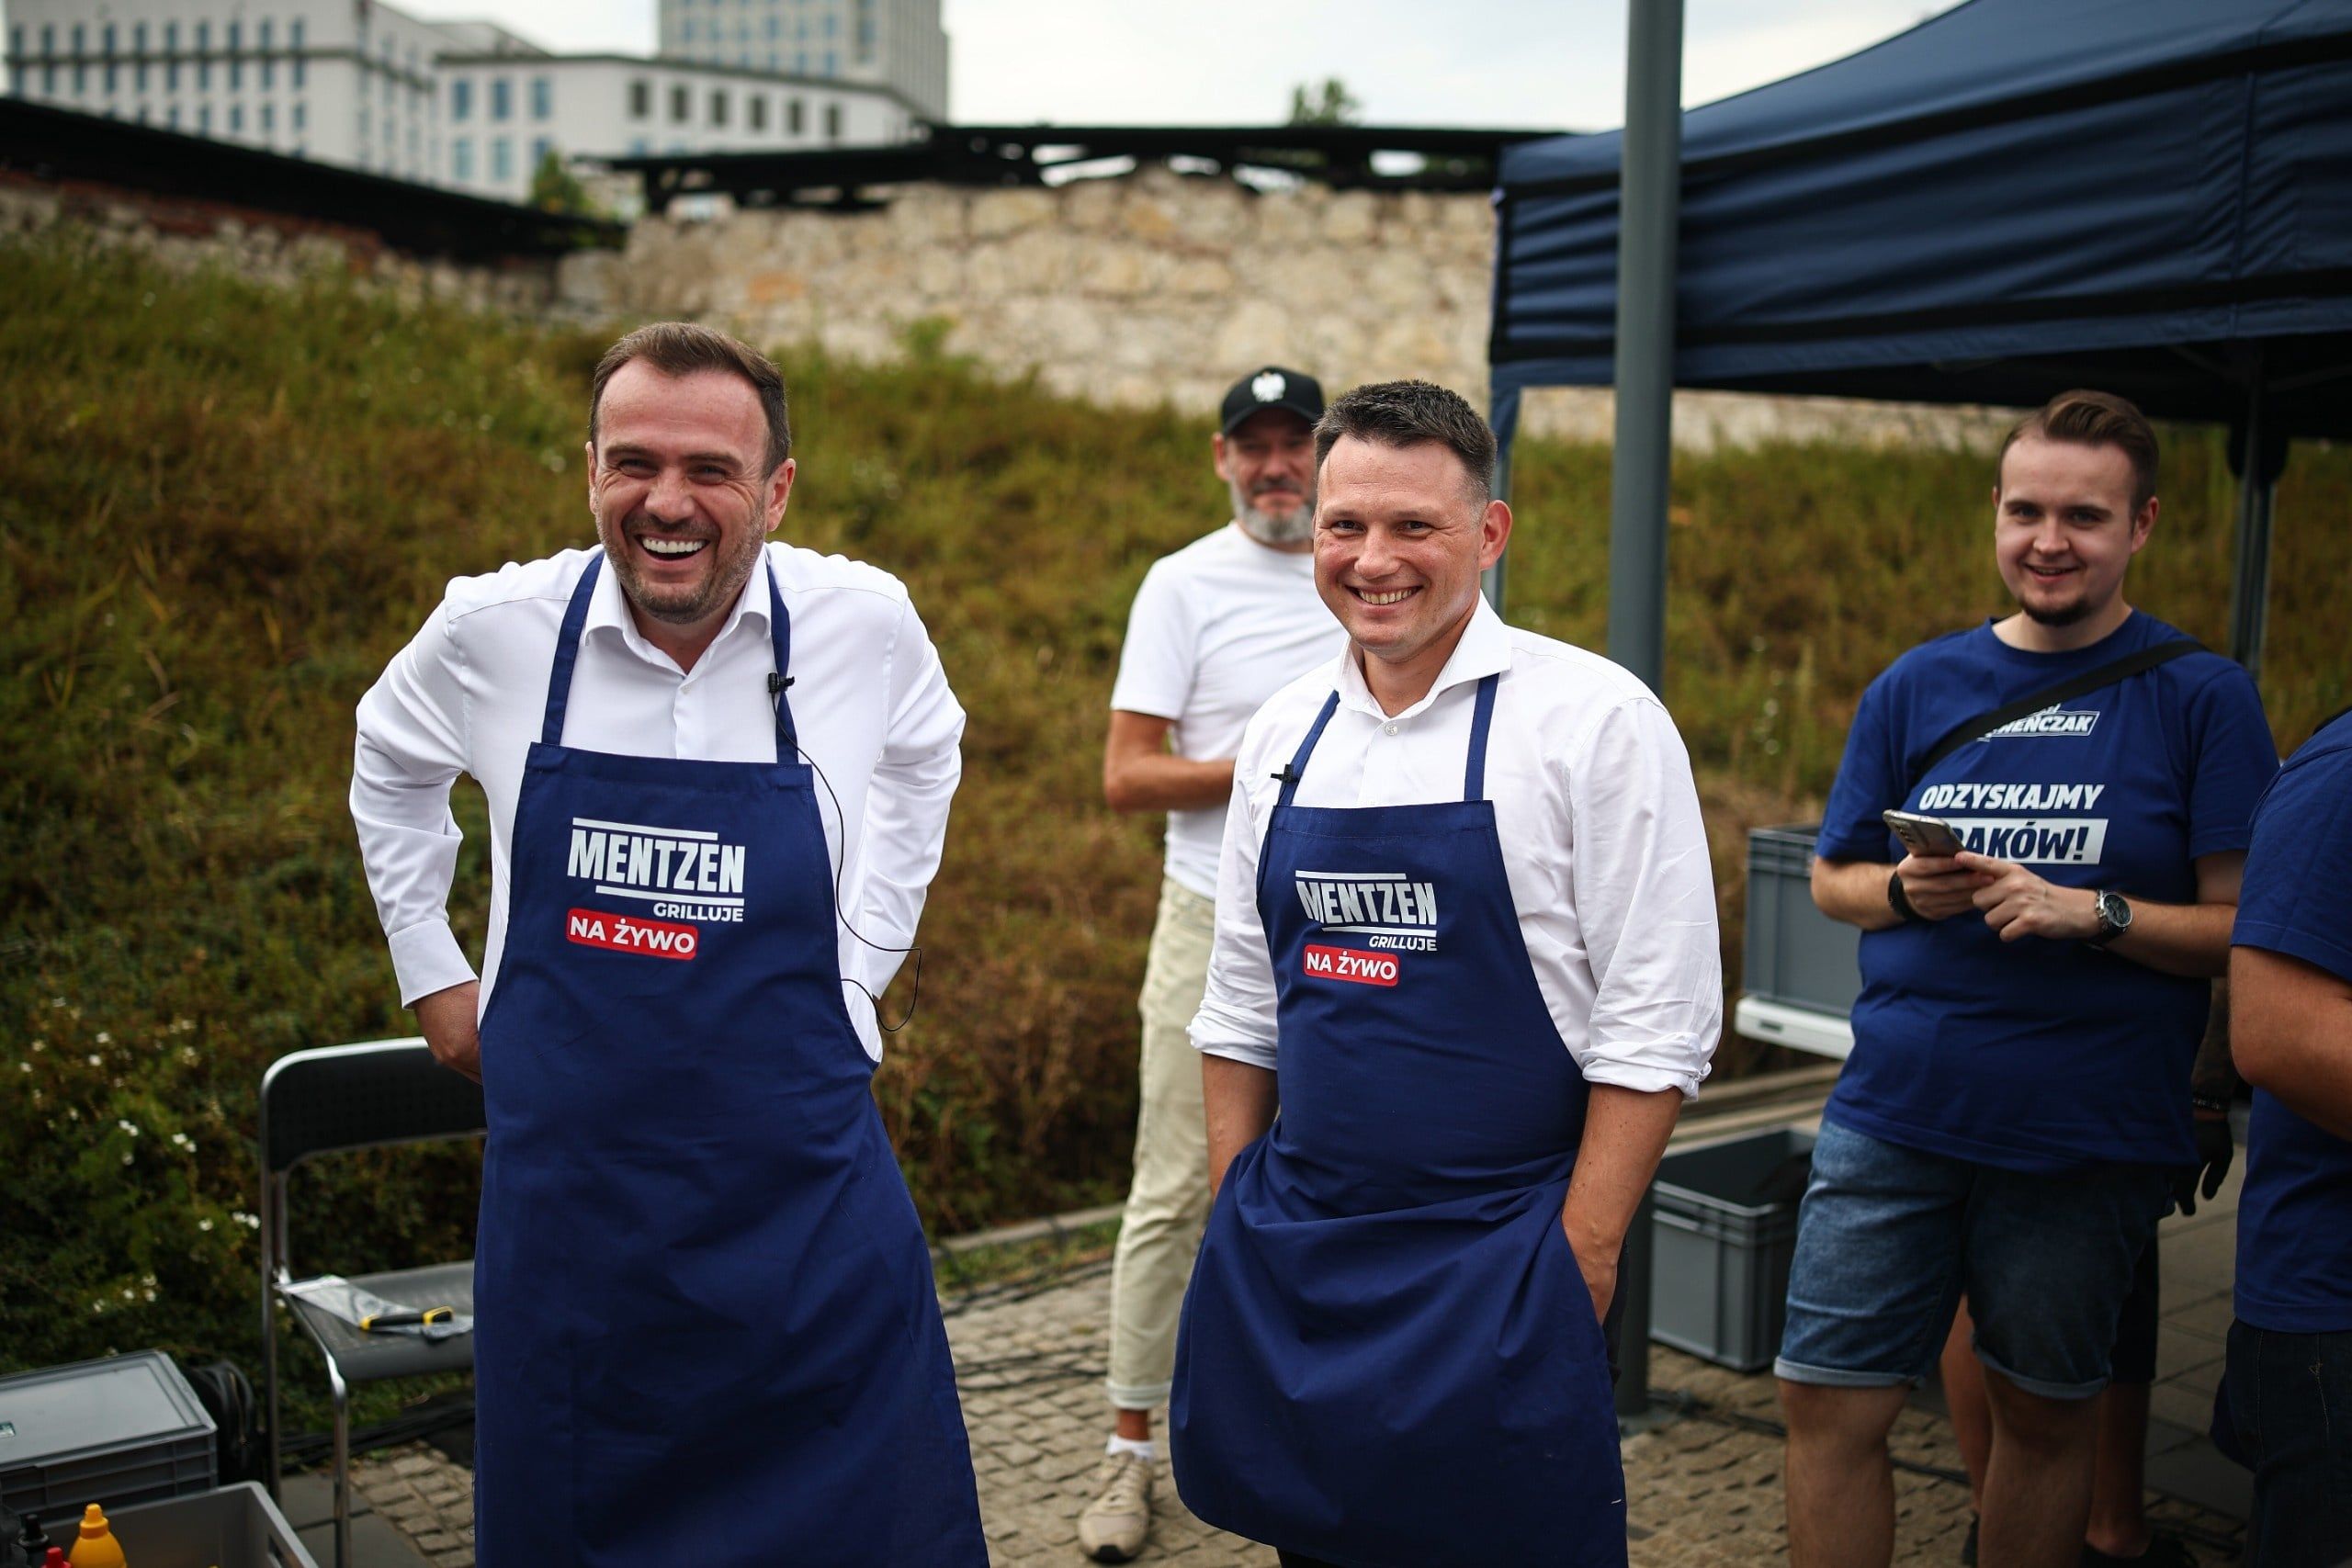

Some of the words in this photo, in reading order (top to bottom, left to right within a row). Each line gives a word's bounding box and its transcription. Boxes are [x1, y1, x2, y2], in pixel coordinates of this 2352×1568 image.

[1919, 784, 2104, 810] ODZYSKAJMY
[1952, 822, 2089, 861] AKÓW!
[567, 829, 745, 893] MENTZEN
[653, 902, 743, 922] GRILLUJE
[1295, 881, 1437, 925] MENTZEN
[571, 916, 605, 942] NA
[613, 919, 695, 953] ŻYWO
[1369, 936, 1437, 951] GRILLUJE
[1306, 953, 1332, 972] NA
[1337, 951, 1396, 980] ŻYWO
